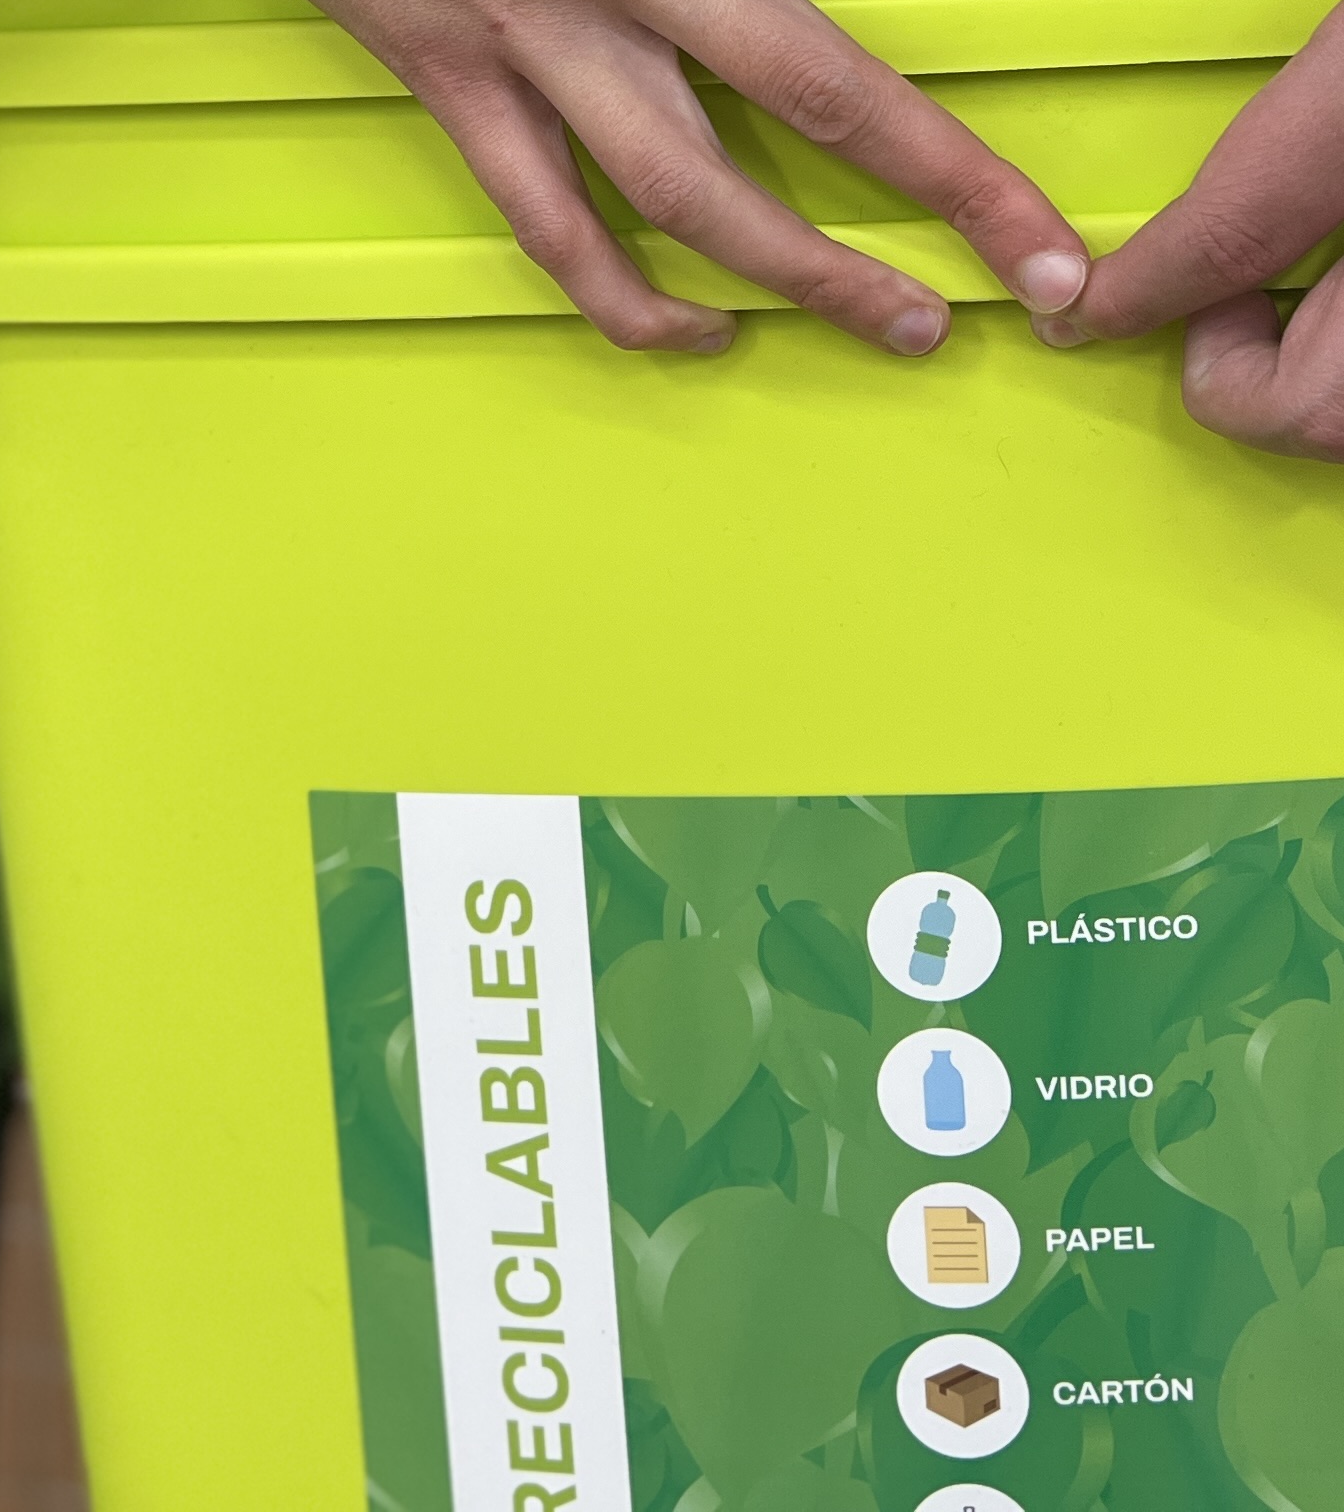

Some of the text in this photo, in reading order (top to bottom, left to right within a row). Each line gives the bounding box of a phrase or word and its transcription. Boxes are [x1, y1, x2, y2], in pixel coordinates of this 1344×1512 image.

[1026, 912, 1199, 946] PLÁSTICO
[1034, 1072, 1155, 1102] VIDRIO
[1045, 1225, 1156, 1253] PAPEL
[1052, 1372, 1195, 1406] CARTÓN
